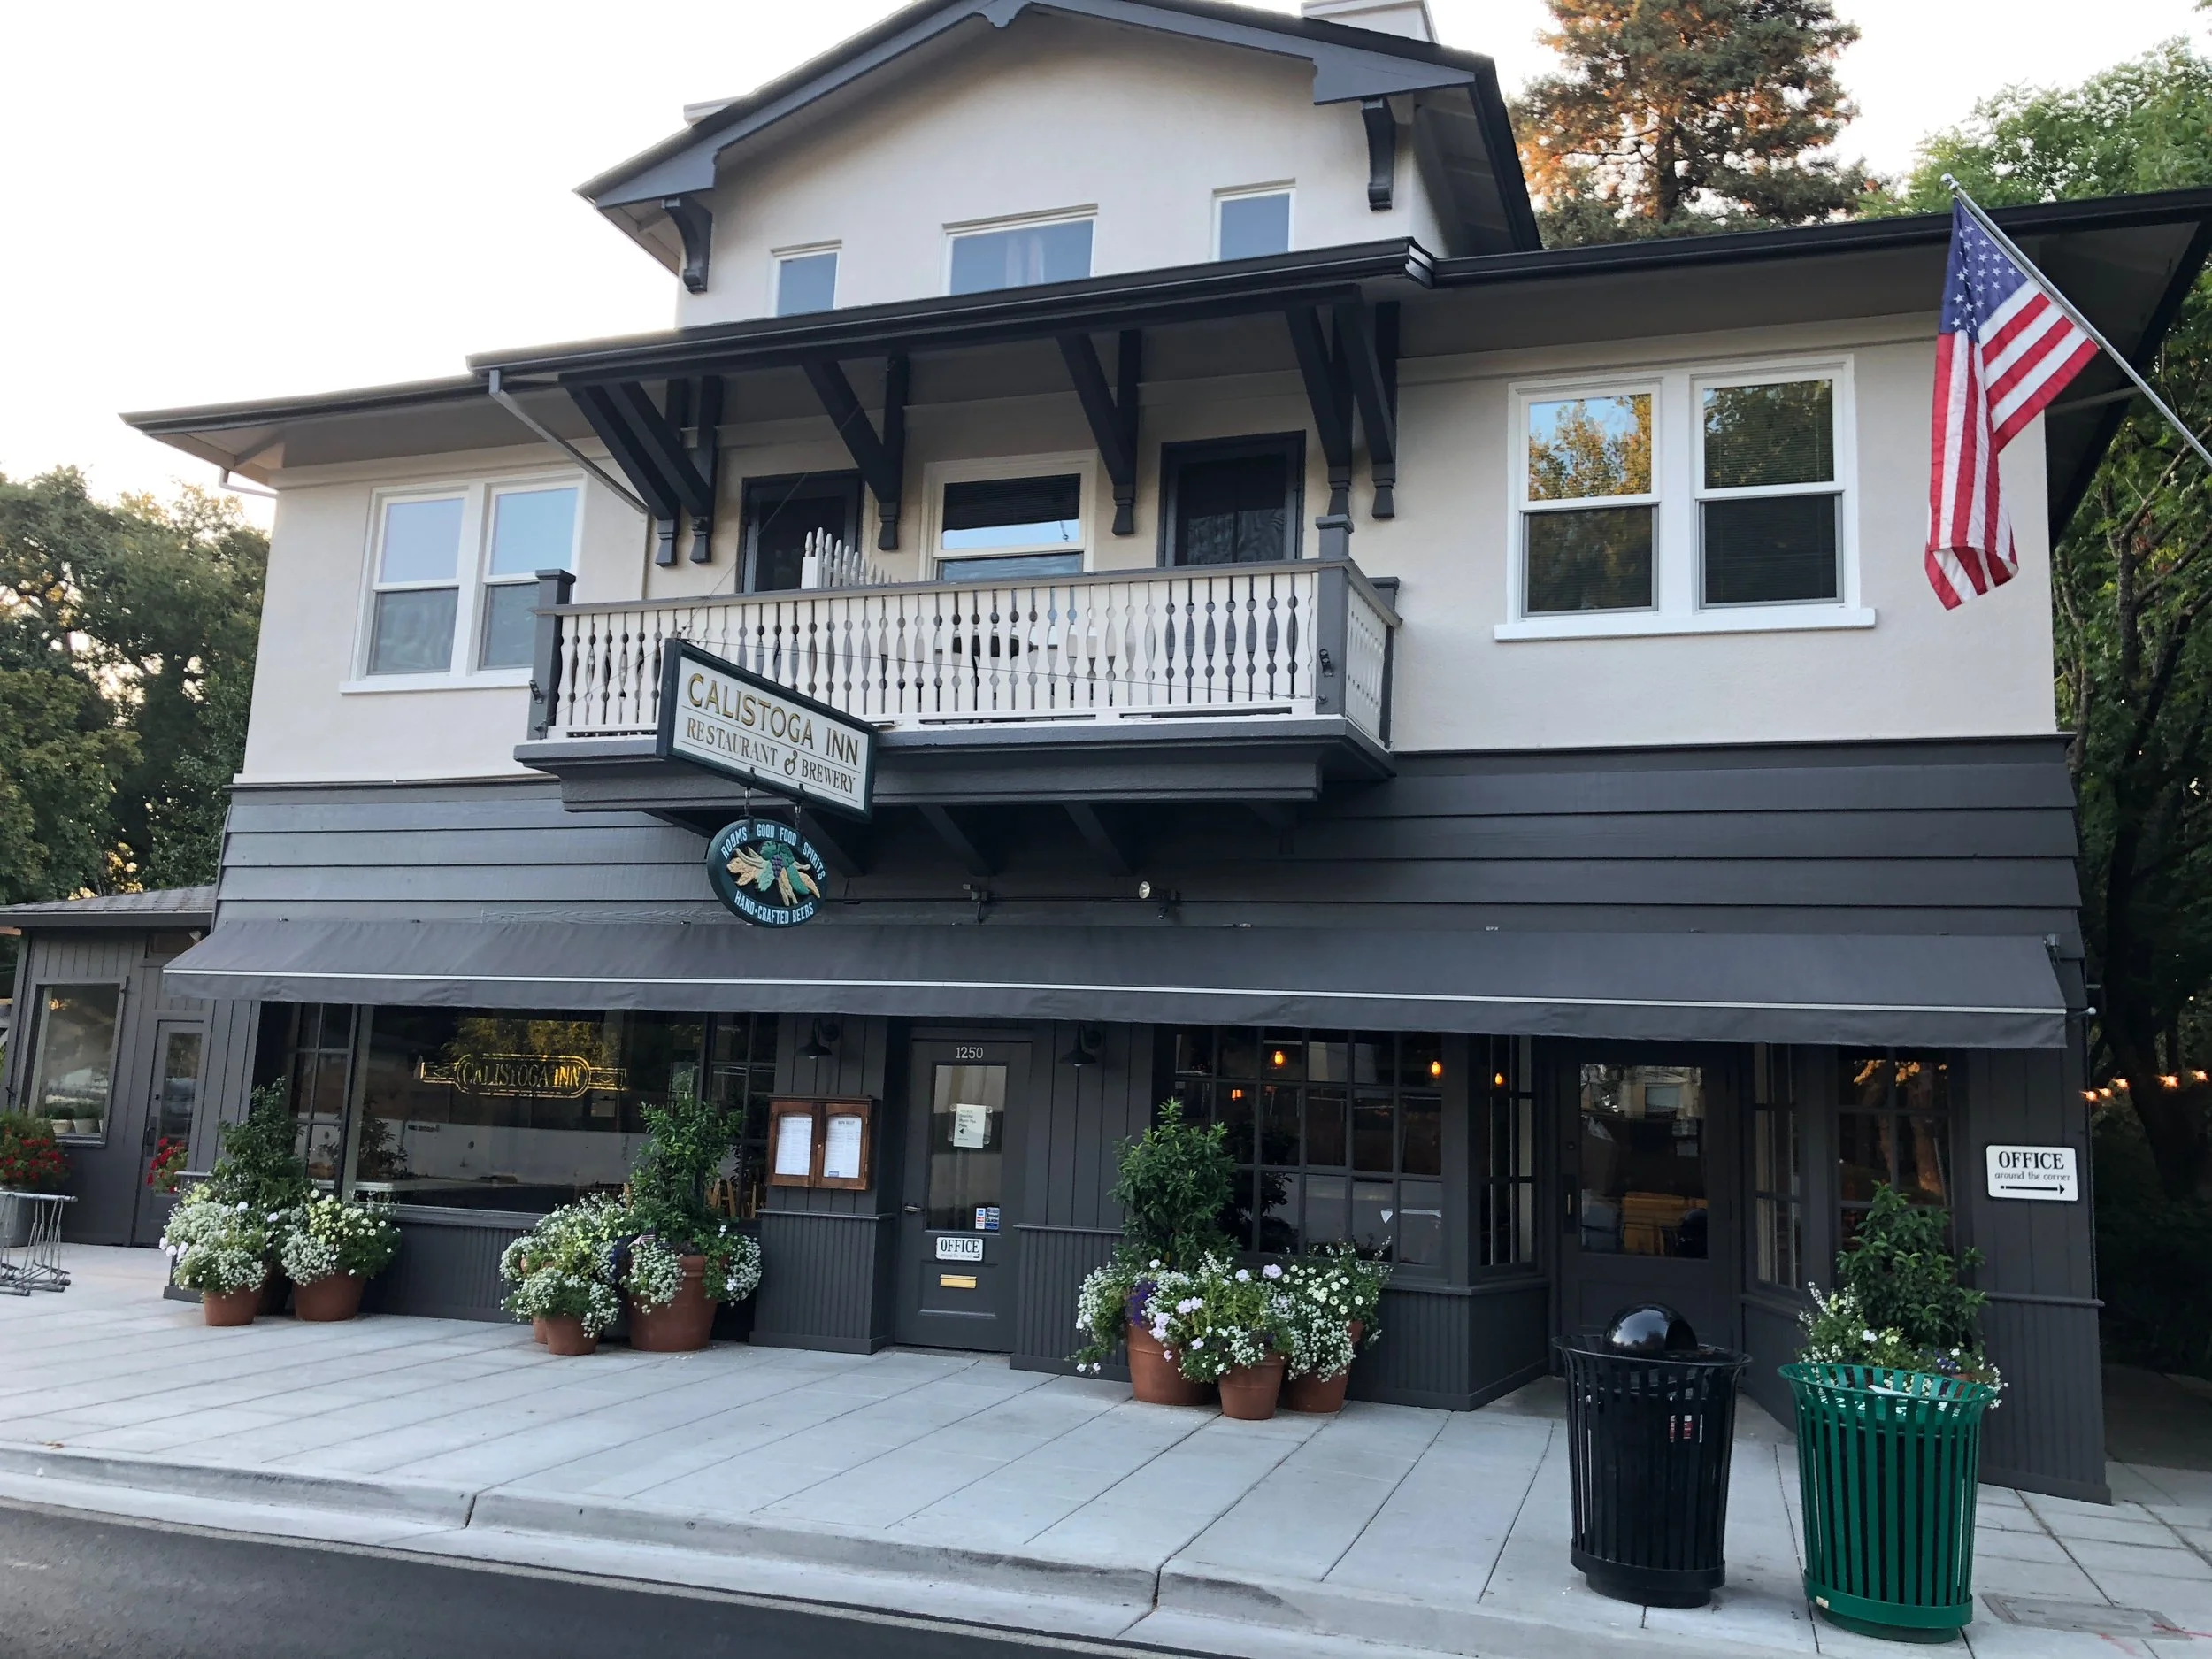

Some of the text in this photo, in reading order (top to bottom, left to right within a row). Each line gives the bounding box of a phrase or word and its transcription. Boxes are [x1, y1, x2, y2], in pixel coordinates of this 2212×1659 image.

[687, 672, 859, 766] CALISTOGA INN
[687, 717, 856, 794] RESTAURANT & BREWERY
[721, 823, 826, 880] ROOMS GOOD FOOD SPIRITS
[792, 902, 814, 923] BEERS
[956, 1046, 984, 1059] 1250
[552, 1065, 581, 1088] INN
[1998, 1151, 2064, 1170] OFFICE
[2028, 1171, 2040, 1180] the
[941, 1239, 979, 1253] OFFICE
